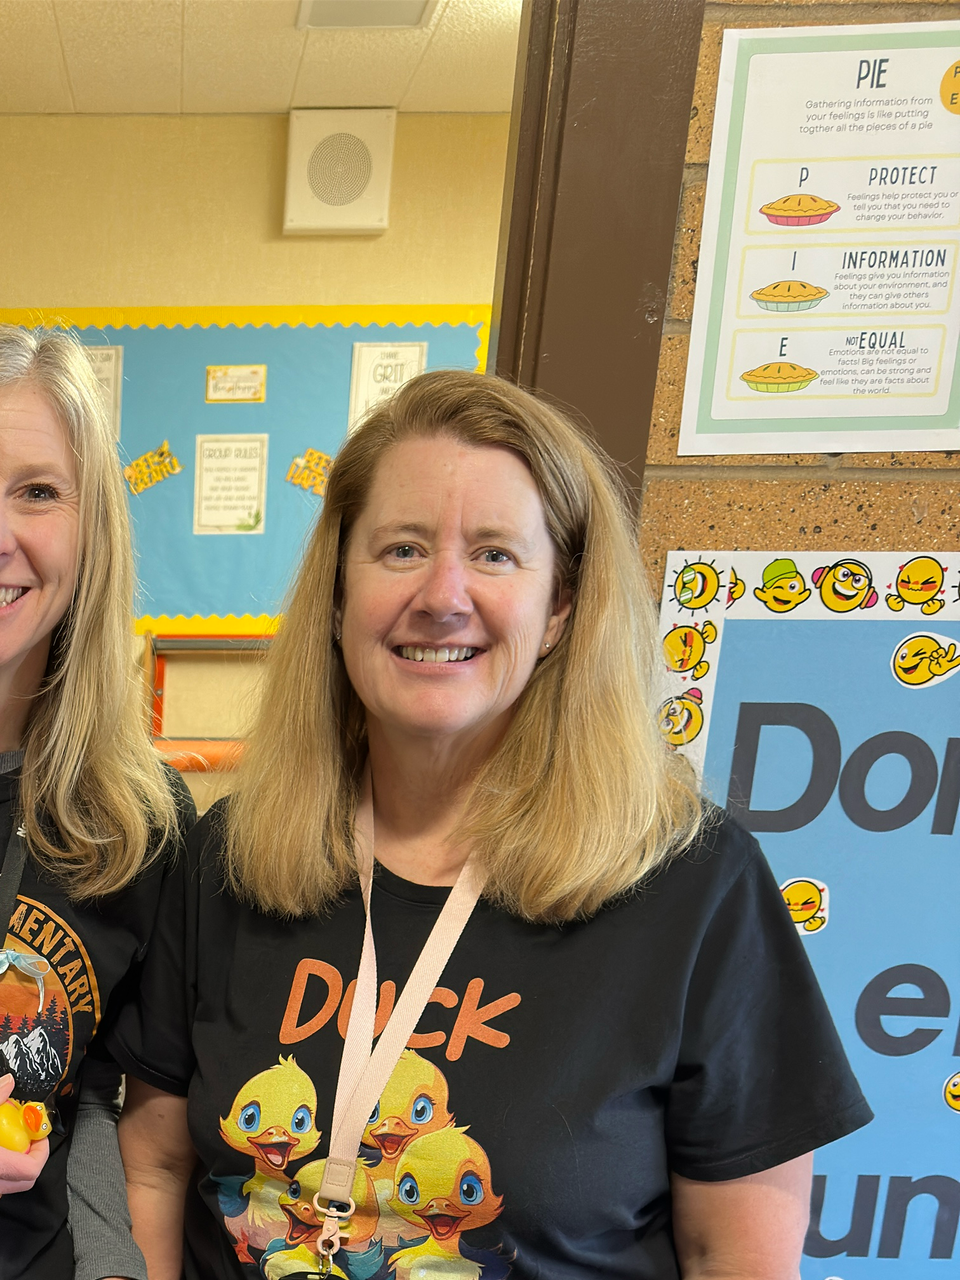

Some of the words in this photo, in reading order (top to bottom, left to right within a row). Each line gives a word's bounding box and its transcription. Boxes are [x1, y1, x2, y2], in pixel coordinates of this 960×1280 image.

[856, 58, 889, 89] PIE
[806, 99, 851, 109] Gathering
[854, 97, 908, 107] information
[911, 96, 933, 105] from
[806, 113, 826, 122] your
[829, 110, 865, 121] feelings
[867, 110, 874, 119] is
[877, 109, 892, 118] like
[895, 109, 929, 119] putting
[799, 123, 834, 134] togther
[836, 122, 846, 132] all
[848, 121, 864, 131] the
[866, 120, 897, 132] pieces
[899, 120, 909, 130] of
[918, 120, 933, 131] pie
[799, 167, 809, 187] P
[868, 166, 937, 186] PROTECT
[848, 193, 880, 201] Feelings
[882, 192, 899, 201] help
[901, 191, 931, 200] protect
[854, 202, 866, 210] tell
[884, 202, 901, 210] that
[919, 201, 939, 209] need
[941, 201, 950, 209] to
[856, 213, 886, 222] change
[888, 214, 905, 222] your
[907, 212, 944, 220] behavior.
[792, 251, 797, 271] I
[842, 249, 947, 269] INFORMATION
[834, 272, 866, 281] Feelings
[868, 271, 885, 280] give
[887, 272, 902, 280] you
[903, 270, 949, 279] information
[858, 283, 878, 291] your
[932, 280, 948, 288] and
[850, 293, 867, 301] they
[884, 291, 902, 300] give
[903, 291, 929, 299] others
[842, 302, 888, 310] information
[915, 301, 931, 309] you.
[845, 336, 859, 346] NOT
[859, 331, 906, 349] EQUAL
[779, 337, 789, 357] E
[278, 958, 521, 1061] DUCK
